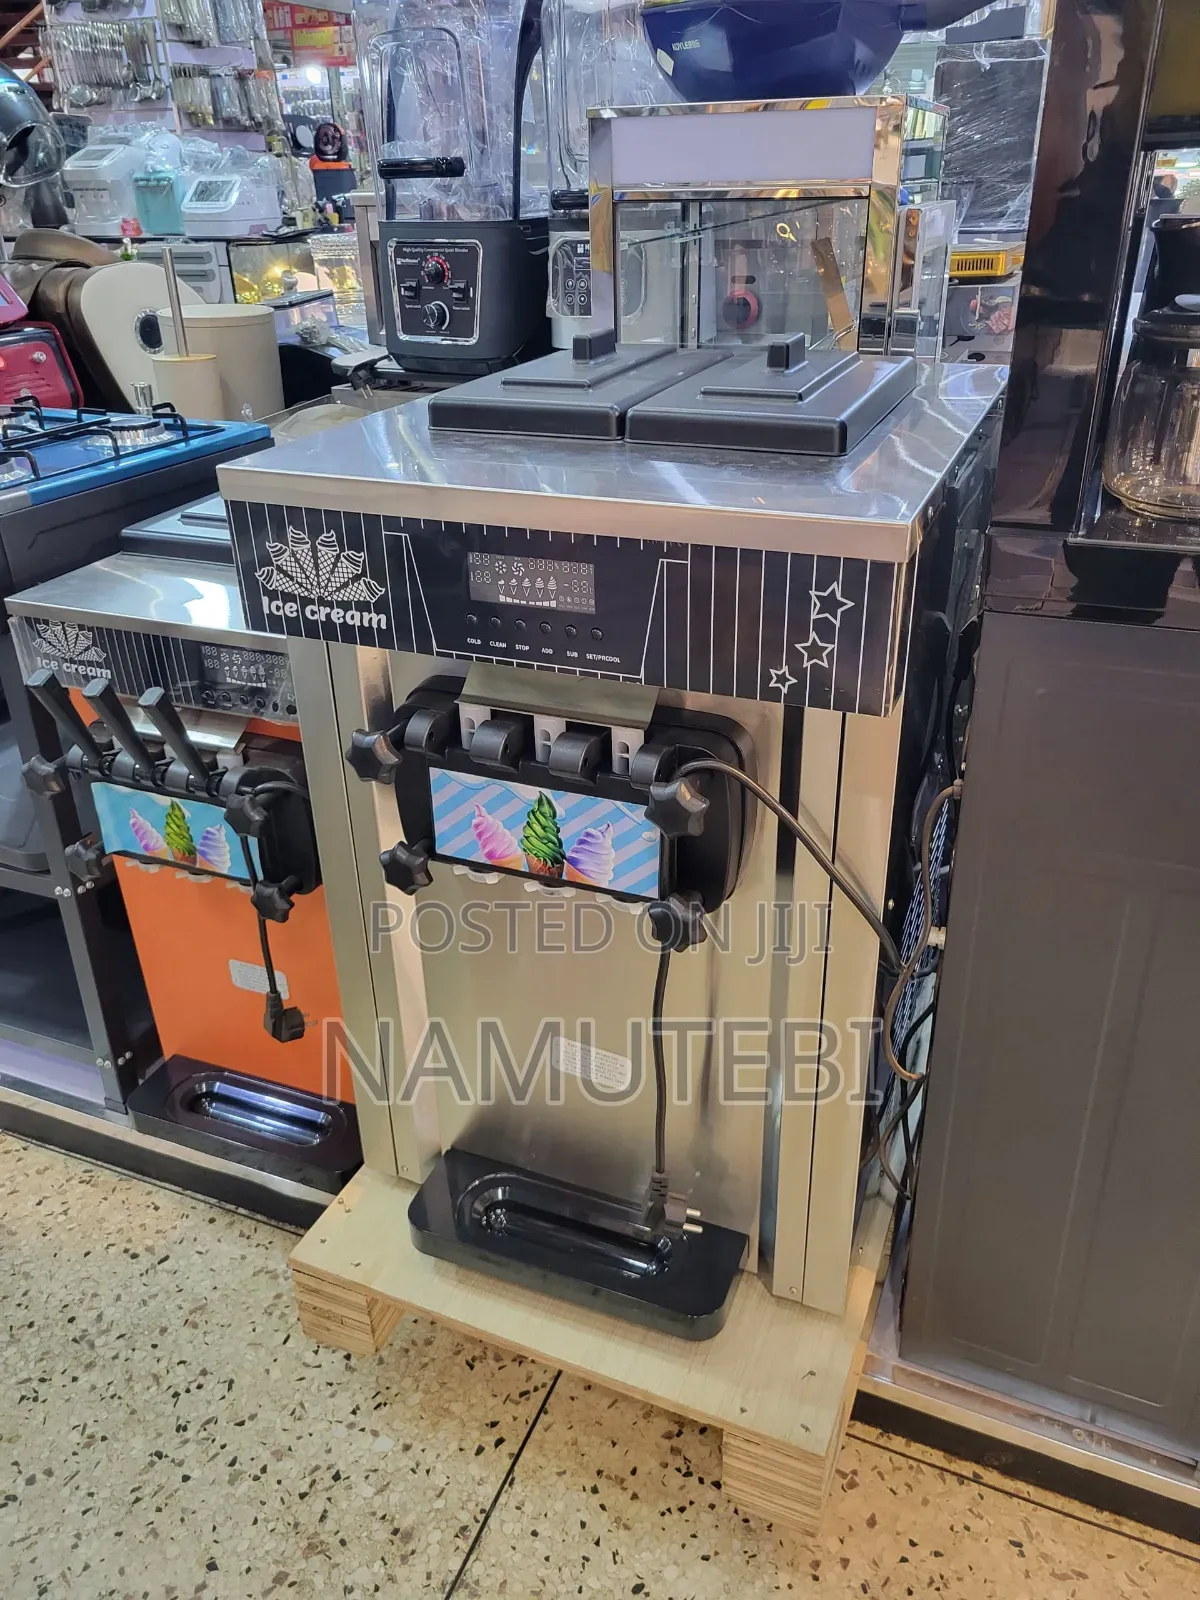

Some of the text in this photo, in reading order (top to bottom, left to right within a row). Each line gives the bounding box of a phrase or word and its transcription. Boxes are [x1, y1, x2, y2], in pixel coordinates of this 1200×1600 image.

[262, 596, 387, 630] Ice cream
[466, 637, 482, 645] COLD
[489, 640, 507, 649] CLEAN
[515, 643, 530, 651] STOP
[541, 647, 553, 655] ADD
[566, 650, 579, 658] SUB
[35, 656, 112, 679] Ice cream
